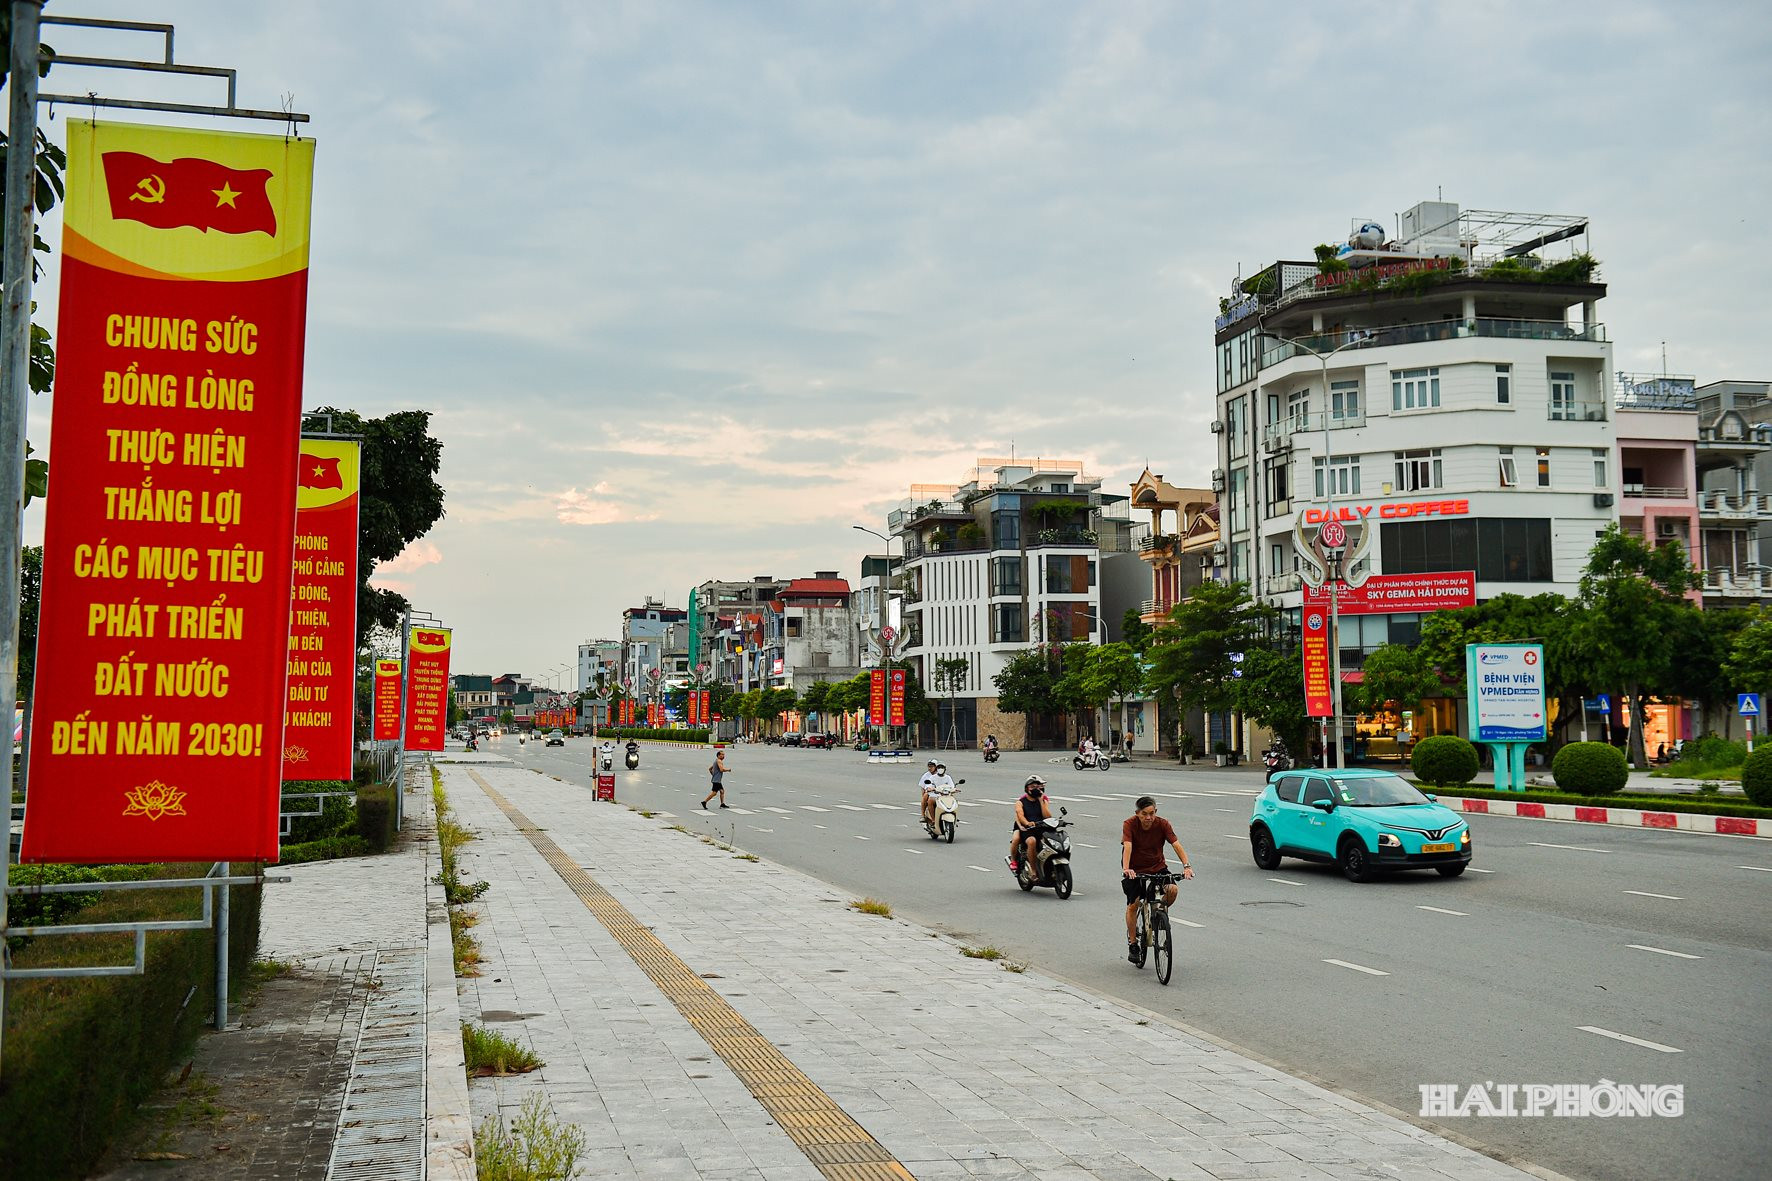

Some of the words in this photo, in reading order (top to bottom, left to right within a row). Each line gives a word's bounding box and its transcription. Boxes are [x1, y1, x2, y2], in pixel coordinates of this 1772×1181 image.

[106, 314, 197, 351] CHUNG
[206, 316, 257, 355] SỨC
[103, 362, 177, 407] ĐỒNG
[186, 370, 254, 411] LÒNG
[107, 429, 174, 470] THỰC
[184, 428, 245, 474] HIỆN
[104, 477, 192, 522] THẮNG
[201, 490, 241, 531] LỢI
[1306, 506, 1372, 524] DAILY
[1380, 500, 1469, 518] COFFEE
[74, 538, 128, 578] CÁC
[138, 547, 198, 587] MỤC
[208, 543, 263, 583] TIÊU
[316, 556, 344, 576] CẢNG
[299, 583, 330, 603] ĐỘNG,
[1367, 591, 1384, 599] SKY
[1387, 589, 1415, 598] GEMIA
[1418, 586, 1433, 597] HẢI
[1436, 587, 1469, 596] DƯƠNG
[88, 598, 159, 637] PHÁT
[167, 594, 243, 640] TRIỂN
[297, 608, 330, 629] THIỆN,
[302, 632, 323, 651] ĐẾN
[95, 651, 148, 695] ĐẤT
[156, 658, 228, 697] NƯỚC
[311, 657, 331, 676] CỦA
[1484, 672, 1509, 685] BỆNH
[1513, 672, 1534, 685] VIỆN
[289, 682, 311, 701] ĐẦU
[315, 685, 328, 702] TƯ
[1480, 687, 1514, 696] VPMED
[293, 709, 331, 727] KHÁCH!
[52, 710, 107, 755] ĐẾN
[116, 715, 180, 756] NĂM
[188, 723, 262, 757] 2030!
